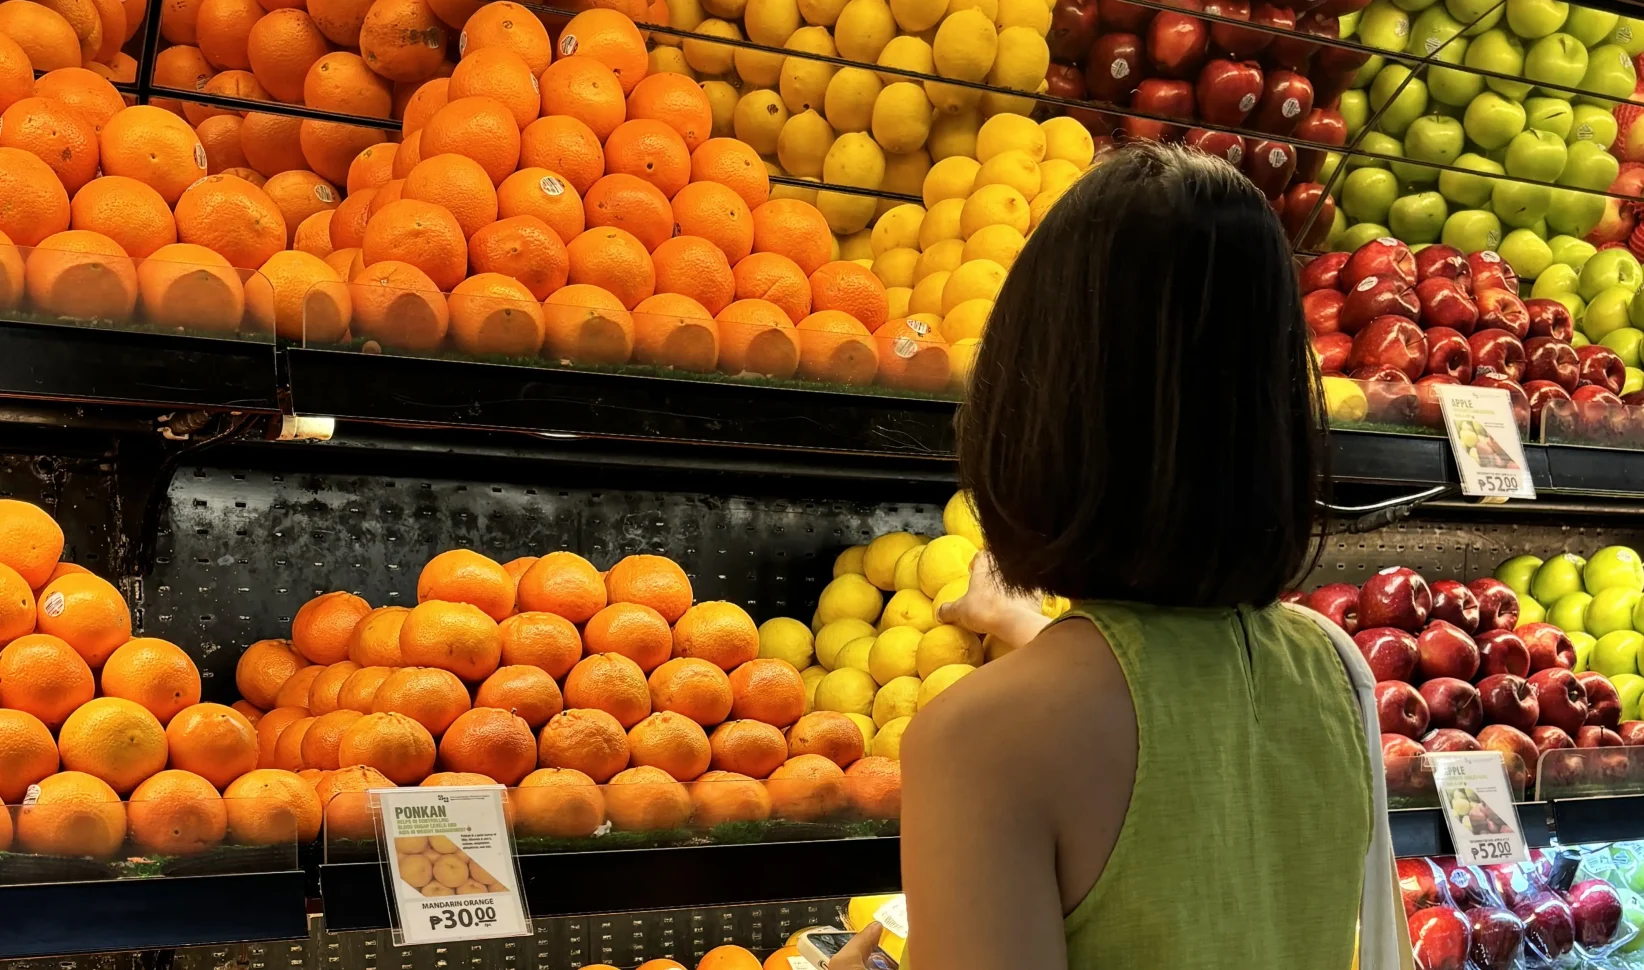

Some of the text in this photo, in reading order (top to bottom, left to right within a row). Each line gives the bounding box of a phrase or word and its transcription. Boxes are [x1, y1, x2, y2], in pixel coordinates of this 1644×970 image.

[1452, 398, 1473, 408] APPLE
[395, 805, 447, 819] PONKAN
[422, 898, 494, 909] MANDARIN ORANGE
